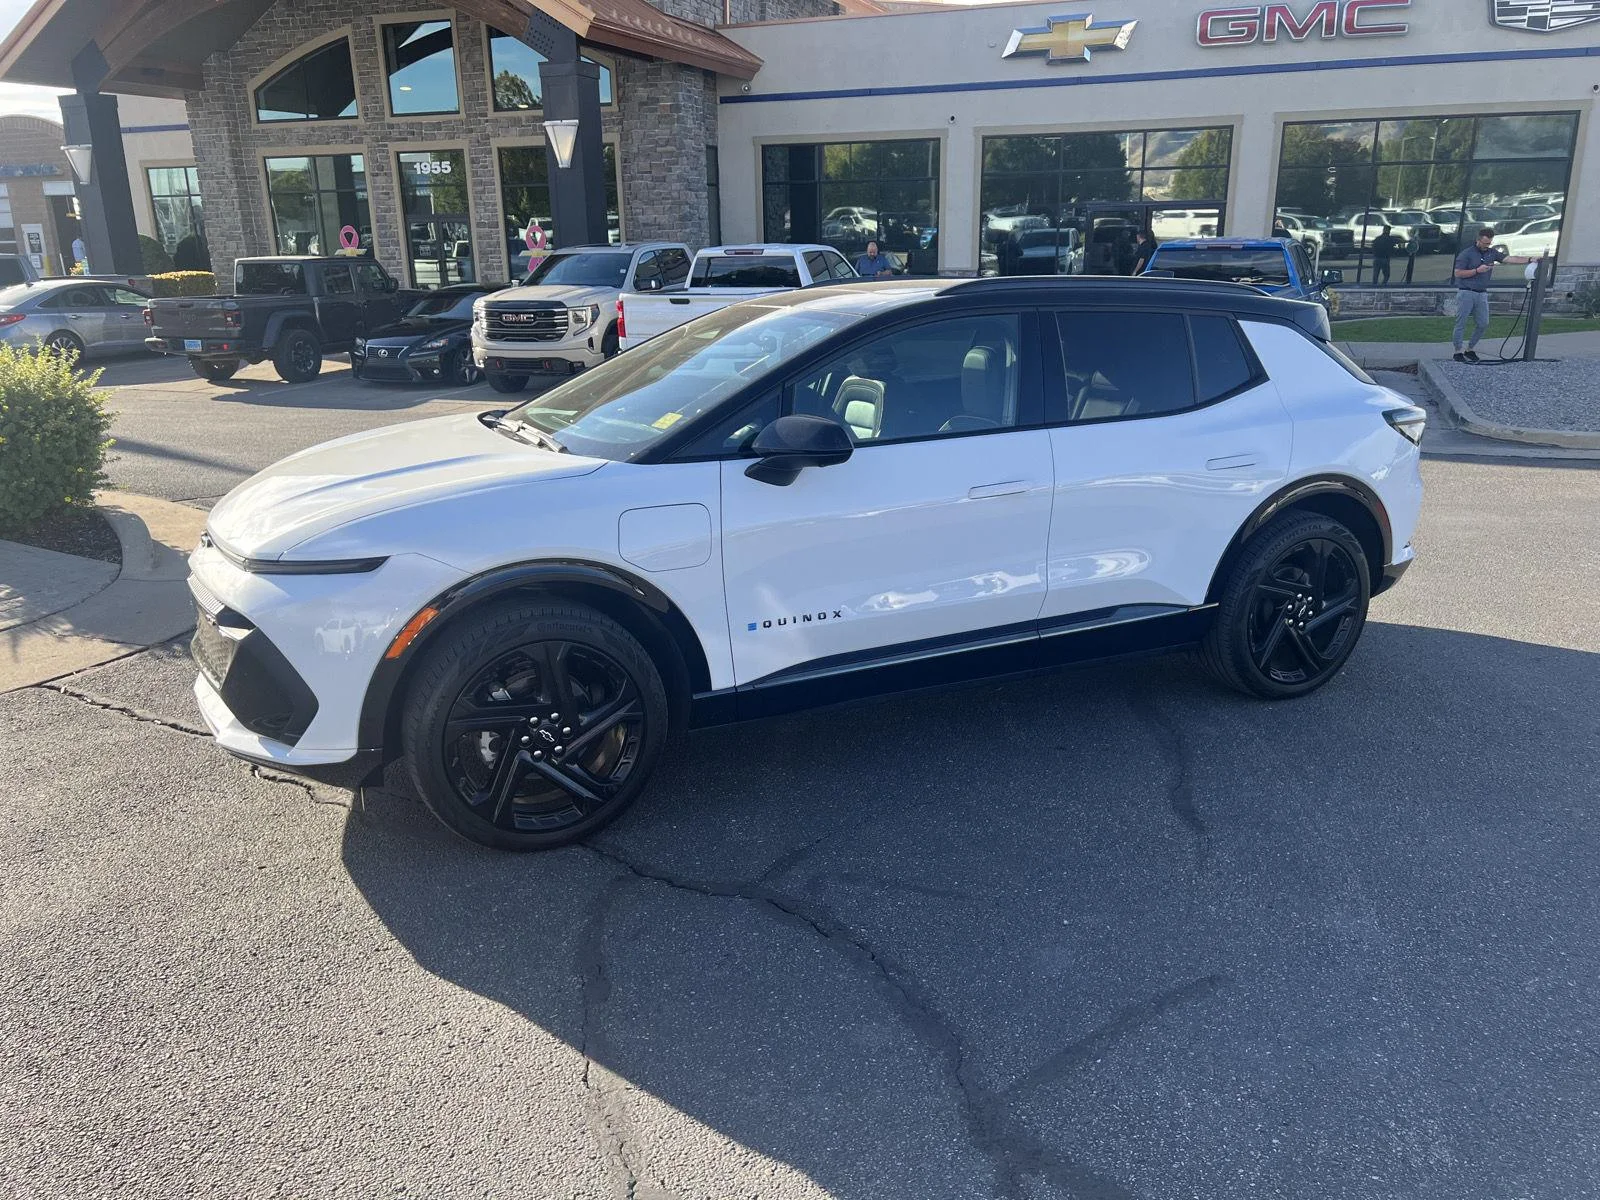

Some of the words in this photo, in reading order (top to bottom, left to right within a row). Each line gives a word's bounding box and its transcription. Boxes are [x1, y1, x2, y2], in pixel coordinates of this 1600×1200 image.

[1196, 0, 1409, 46] GMC
[413, 160, 452, 175] 1955
[501, 313, 534, 322] GMC
